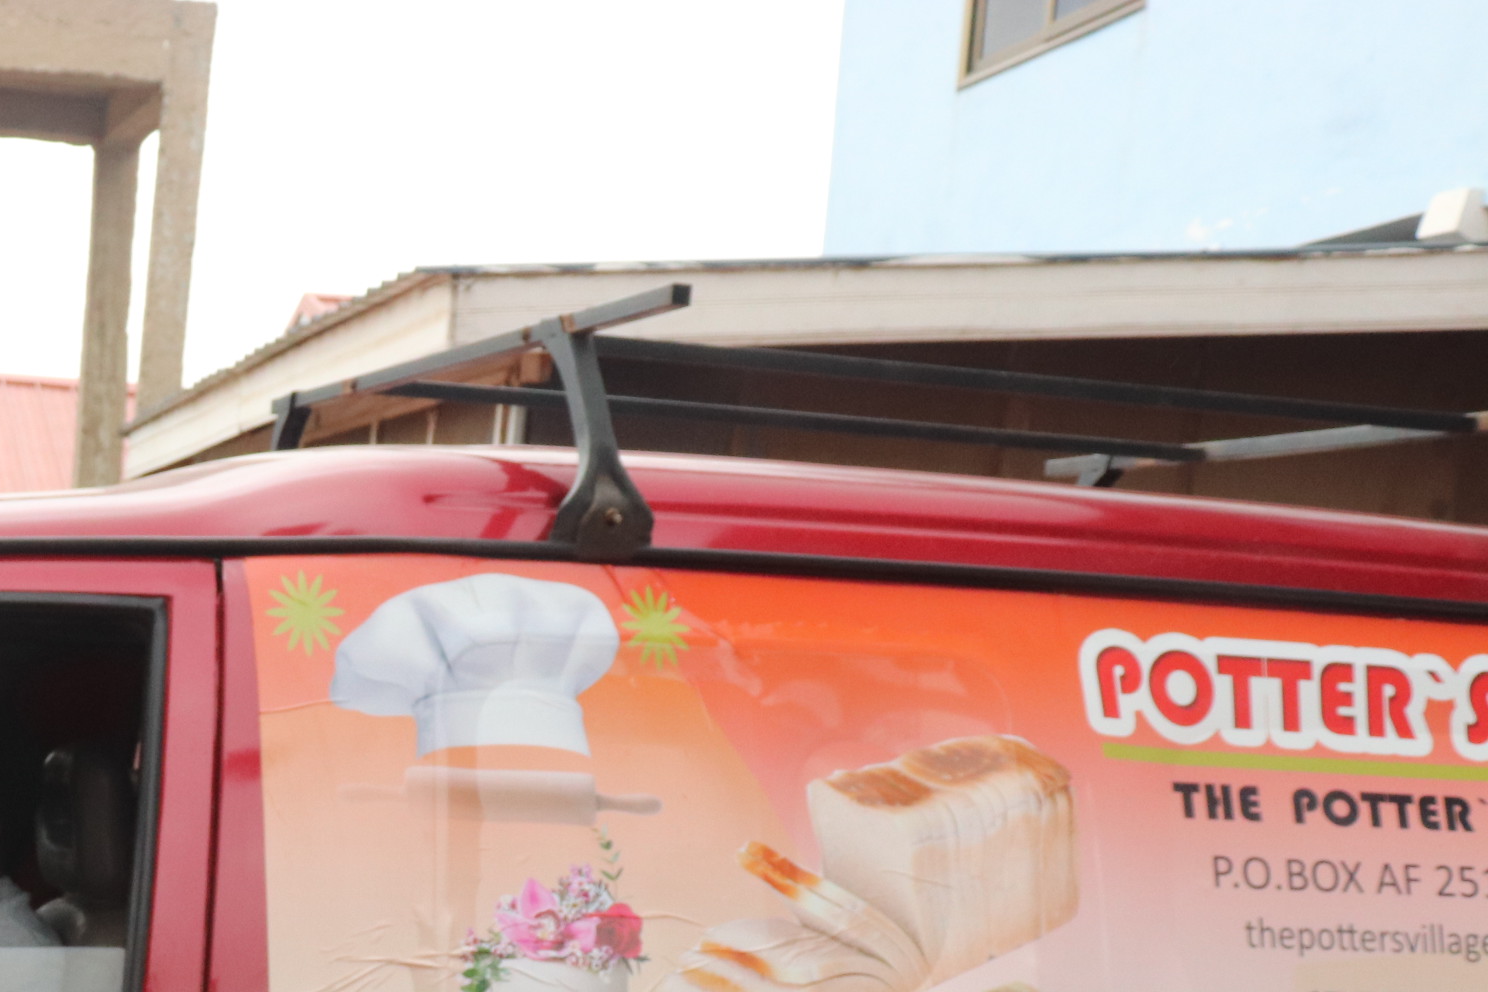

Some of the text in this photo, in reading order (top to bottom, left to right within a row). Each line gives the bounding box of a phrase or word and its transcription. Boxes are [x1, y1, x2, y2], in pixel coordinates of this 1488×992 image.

[1172, 782, 1263, 822] THE
[1213, 856, 1365, 895] P.O.BOX
[1376, 864, 1422, 895] AF
